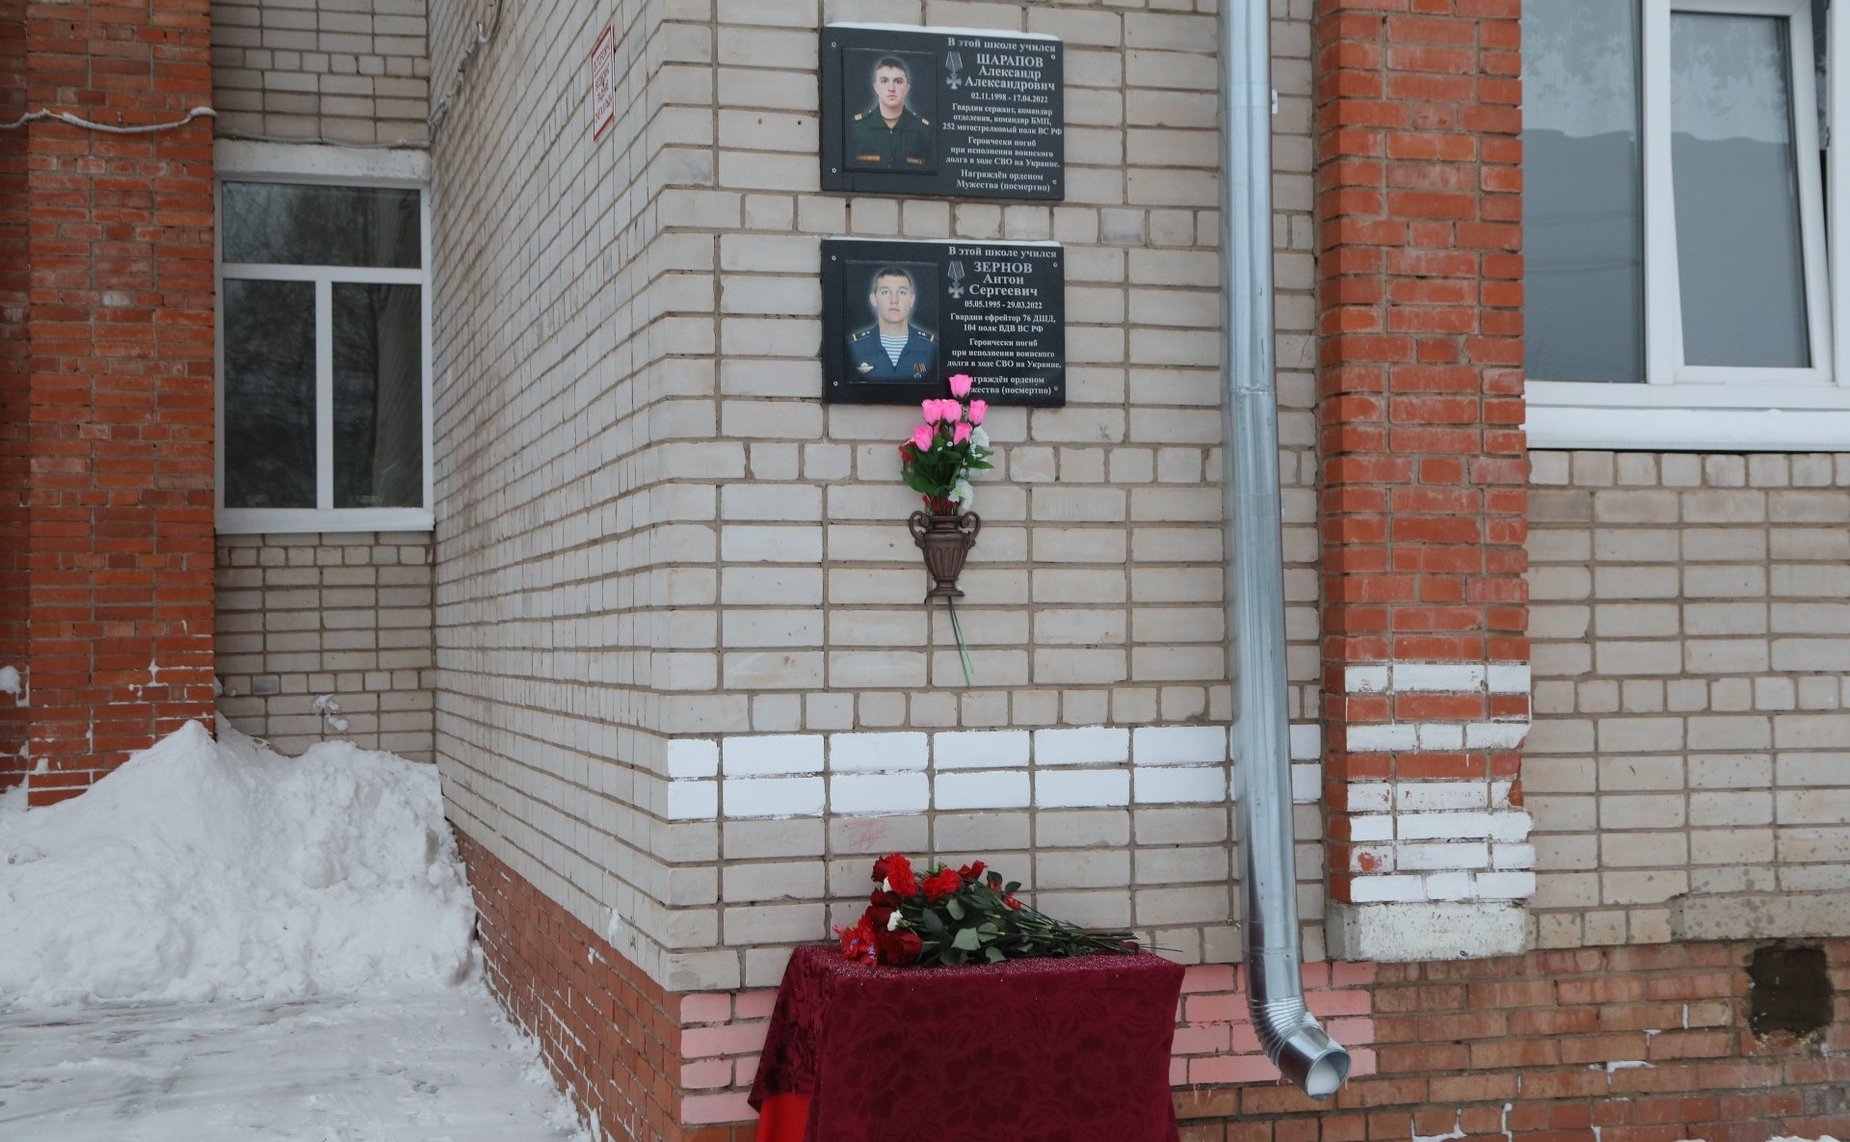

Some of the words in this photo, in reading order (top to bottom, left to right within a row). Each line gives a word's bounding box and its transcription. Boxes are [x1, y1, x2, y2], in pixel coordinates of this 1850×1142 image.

[948, 38, 955, 46] В
[959, 39, 980, 47] этой
[984, 41, 1017, 50] школе
[1020, 43, 1056, 52] учился
[976, 54, 1044, 67] ШАРАПОВ
[979, 65, 1041, 81] Александр
[965, 76, 1055, 92] Александрович
[971, 92, 1006, 100] 02.11.1998
[1013, 94, 1048, 103] 17.04.2022
[985, 106, 1016, 114] сержант,
[1018, 108, 1052, 117] командир
[994, 118, 1029, 126] командир
[957, 124, 1016, 133] мотострелковый
[968, 136, 1012, 146] Героически
[968, 148, 1012, 156] исполнении
[961, 170, 1007, 179] Награждён
[1010, 173, 1043, 181] орденом
[956, 180, 998, 190] Мужества
[1000, 182, 1050, 192] (посмертно)
[949, 246, 956, 255] В
[959, 248, 982, 256] этой
[1021, 250, 1056, 258] учился
[974, 262, 1032, 274] ЗЕРНОВ
[983, 274, 1024, 284] Антон
[969, 284, 1038, 298] Сергеевич
[985, 314, 1020, 322] ефрейтор
[970, 338, 1014, 346] Героически
[1027, 360, 1062, 369] Украине.
[970, 376, 1008, 384] граждён
[1010, 376, 1044, 385] орденом
[1002, 386, 1052, 396] (посмертно)
